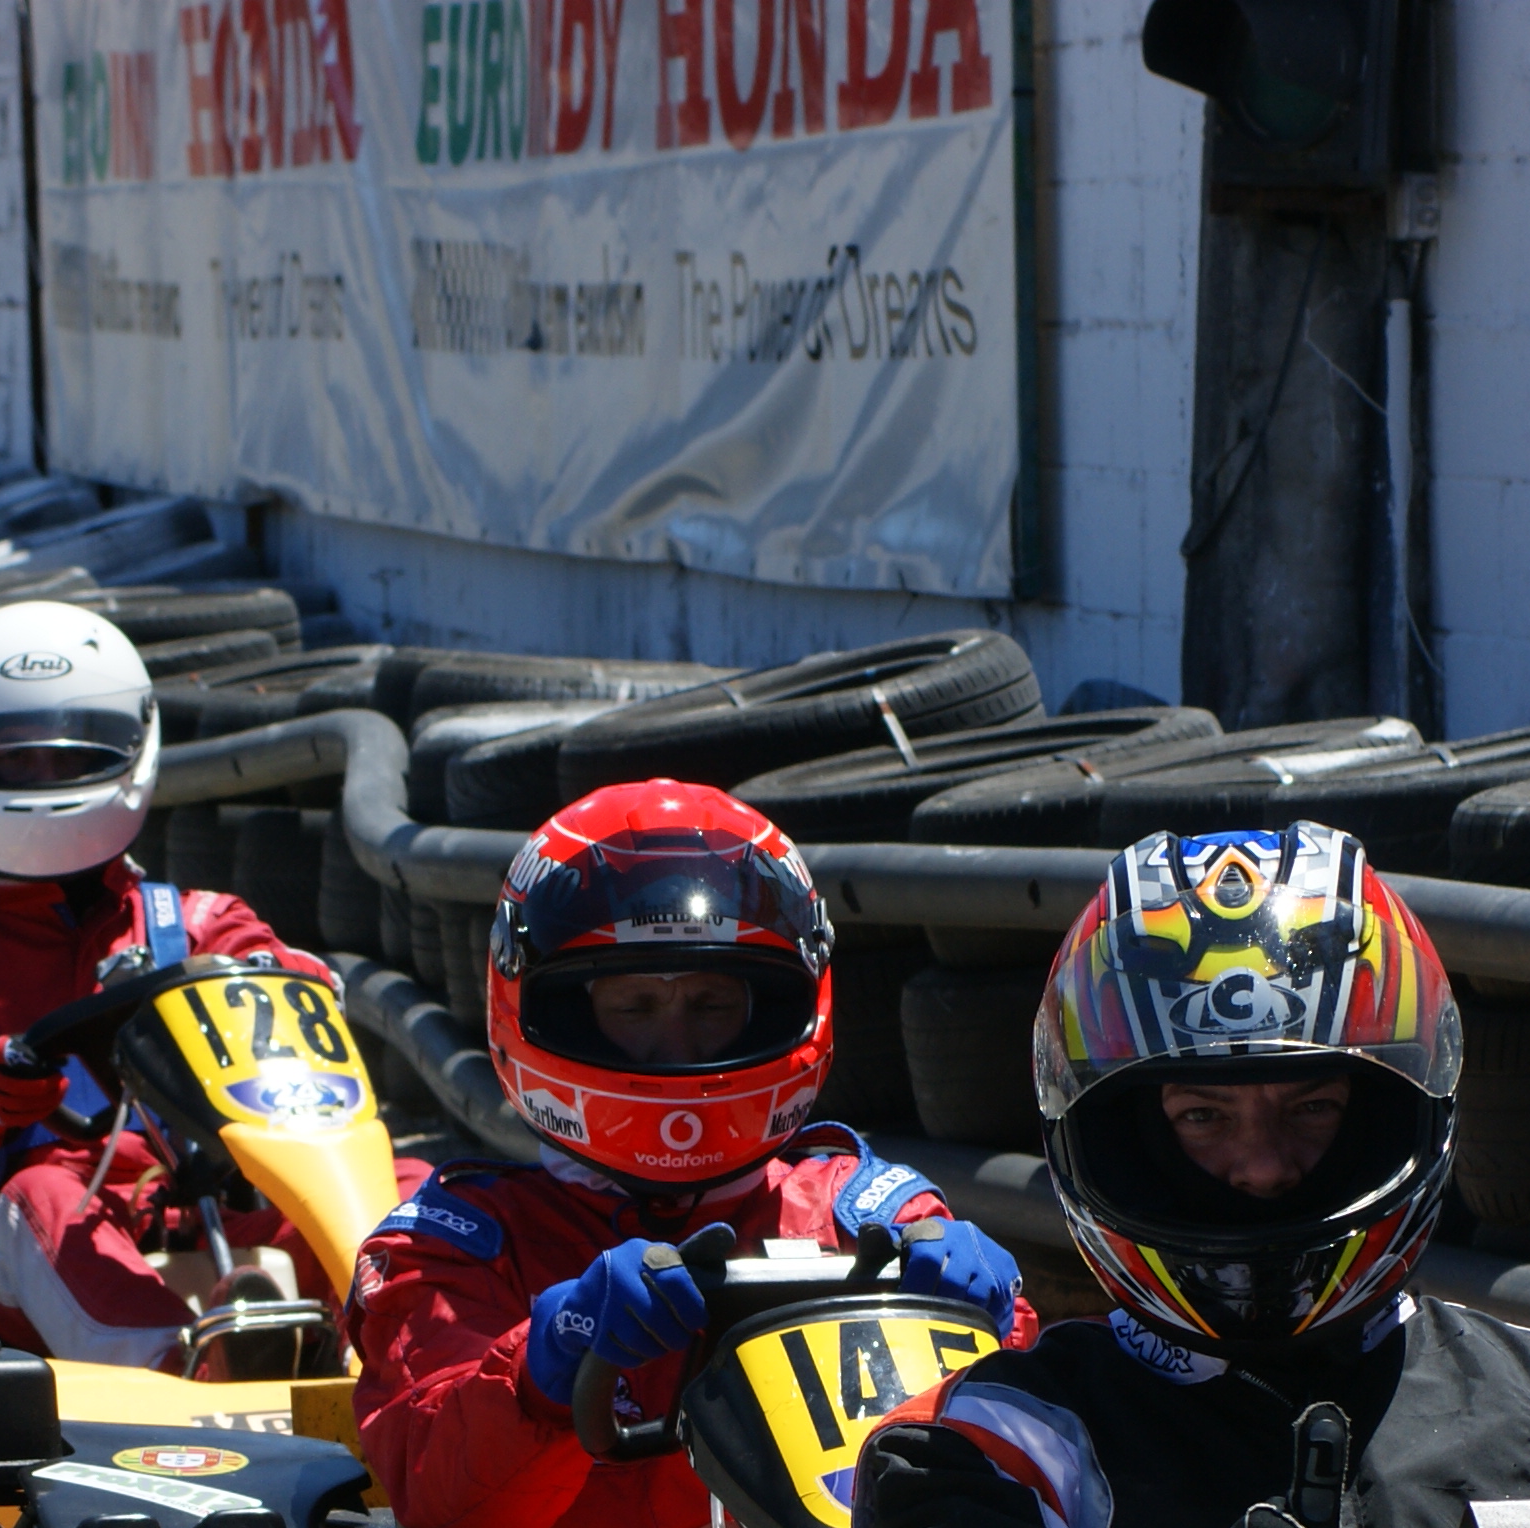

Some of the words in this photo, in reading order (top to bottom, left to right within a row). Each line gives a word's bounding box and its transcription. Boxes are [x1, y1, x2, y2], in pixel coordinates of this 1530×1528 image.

[657, 0, 992, 151] HONDA
[675, 251, 722, 360] The
[841, 245, 977, 359] Dreams
[14, 653, 66, 672] Arai
[182, 981, 350, 1070] 128
[522, 1095, 584, 1140] Marlboro
[634, 1151, 725, 1168] vodafone
[855, 1166, 917, 1212] sparco
